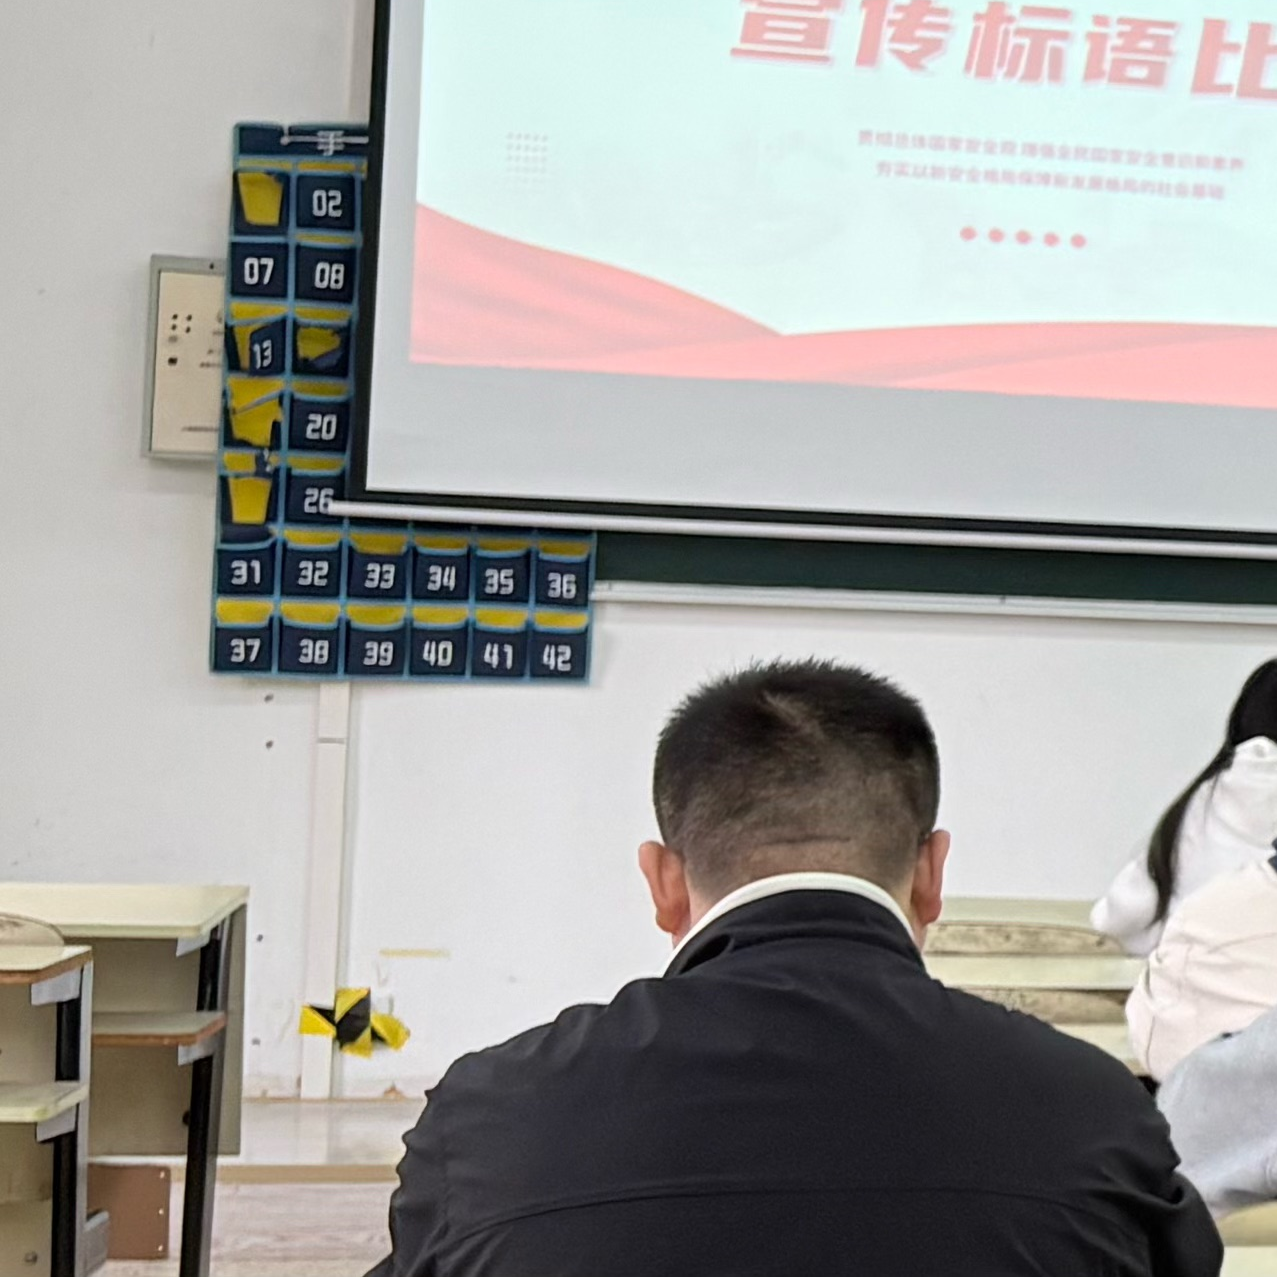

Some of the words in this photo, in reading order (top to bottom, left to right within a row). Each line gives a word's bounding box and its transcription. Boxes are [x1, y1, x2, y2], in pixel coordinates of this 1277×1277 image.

[312, 189, 342, 217] 02
[244, 257, 274, 285] 07
[314, 261, 345, 289] 08
[253, 339, 272, 369] 13
[305, 413, 337, 440] 20
[303, 489, 335, 515] 26
[231, 559, 261, 585] 31
[298, 560, 329, 586] 32
[364, 562, 396, 589] 33
[427, 565, 456, 591] 34
[485, 568, 514, 595] 35
[548, 572, 577, 599] 36
[230, 638, 261, 663] 37
[299, 638, 329, 664] 38
[363, 641, 394, 666] 39
[422, 640, 453, 667] 40
[483, 643, 513, 669] 41
[542, 645, 572, 672] 42
